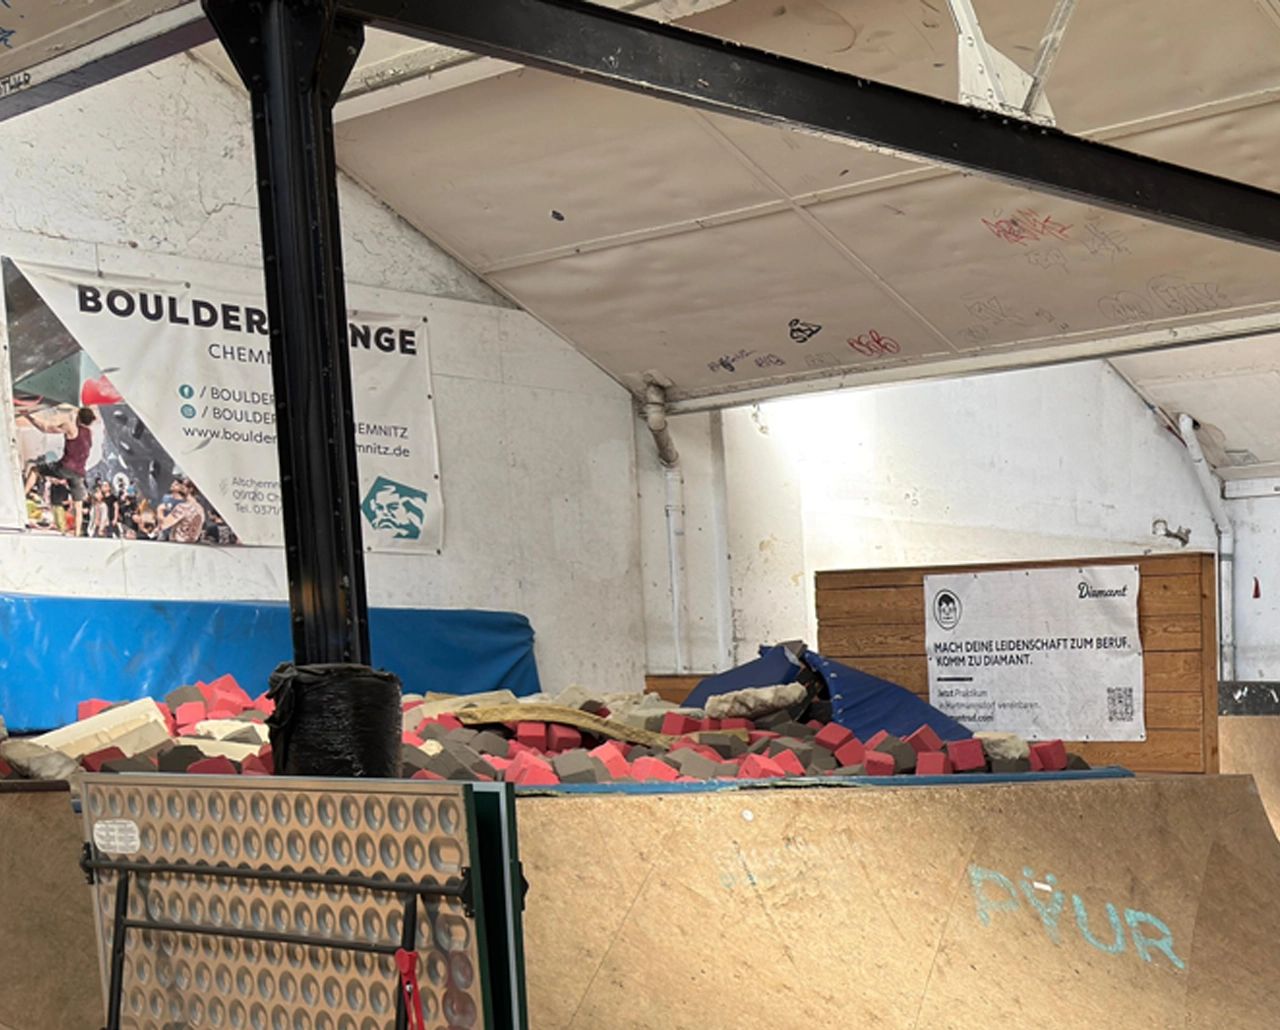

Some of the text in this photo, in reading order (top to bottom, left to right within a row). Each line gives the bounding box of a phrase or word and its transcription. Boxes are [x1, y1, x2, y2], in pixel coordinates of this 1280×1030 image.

[208, 343, 274, 365] CHEM
[211, 387, 275, 406] BOULDER
[1077, 581, 1128, 600] Diamant
[934, 636, 1131, 653] MACH DEINE LEIDENSCHAFT ZUM BERUF.
[936, 653, 1033, 667] KOMM ZU DIAMANT.
